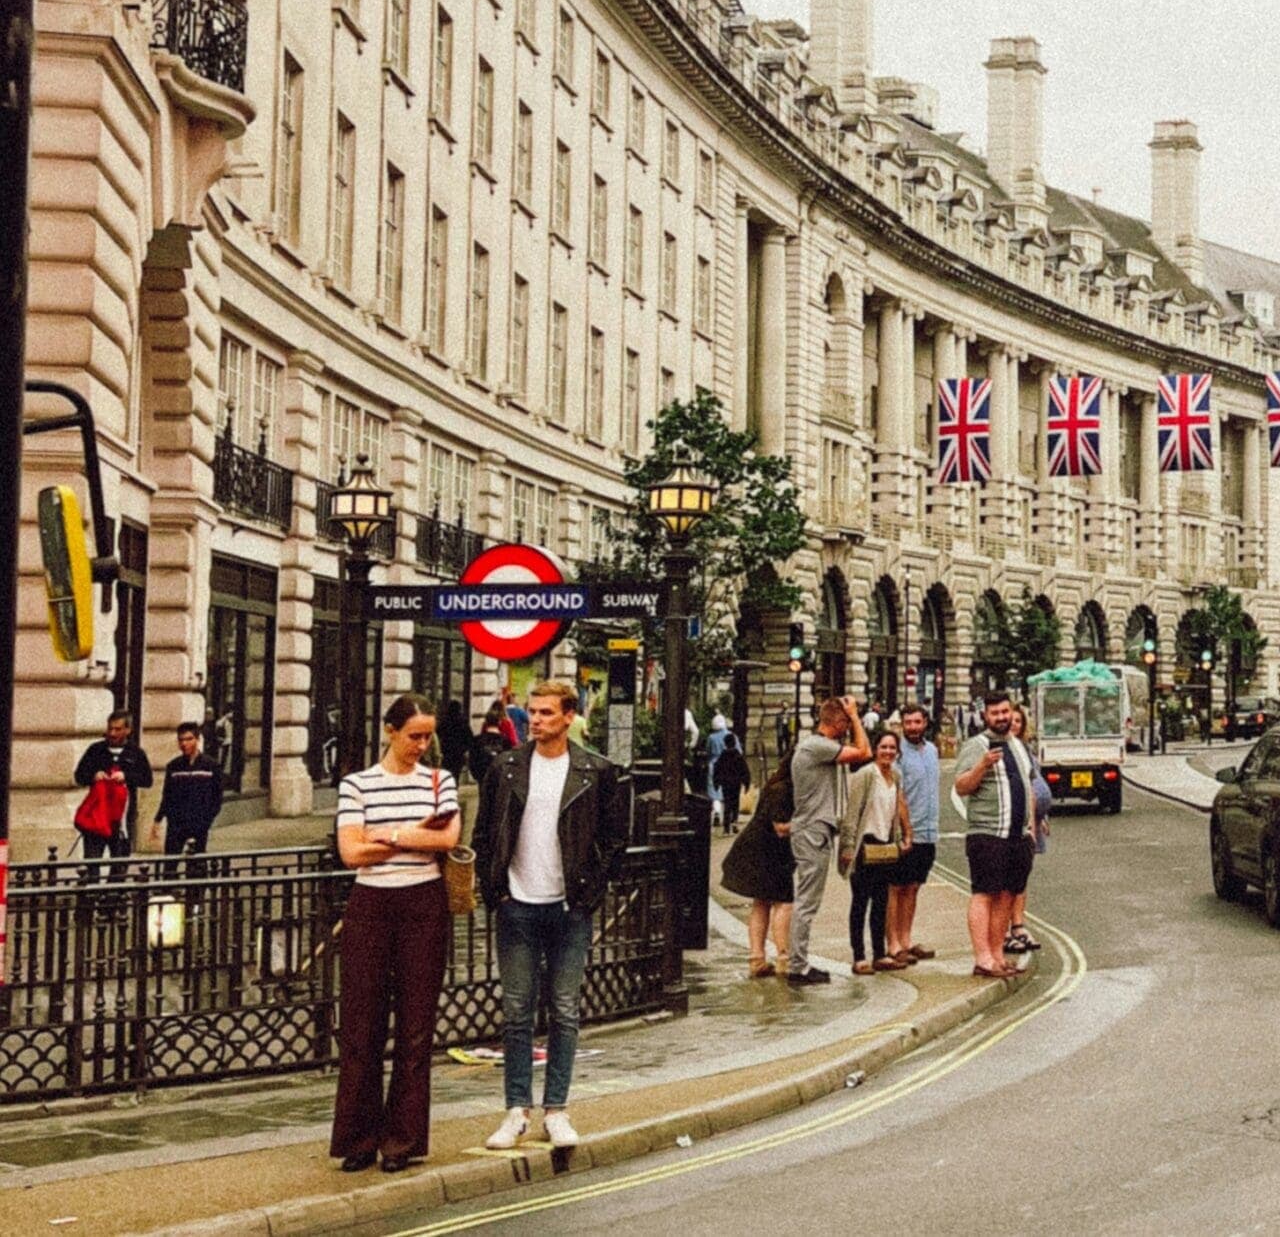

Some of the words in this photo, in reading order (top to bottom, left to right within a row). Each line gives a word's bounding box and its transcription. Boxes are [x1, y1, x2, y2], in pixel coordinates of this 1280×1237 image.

[374, 596, 422, 609] PUBLIC
[439, 593, 584, 610] UNDERGROUND
[602, 594, 659, 608] SUBWAY
